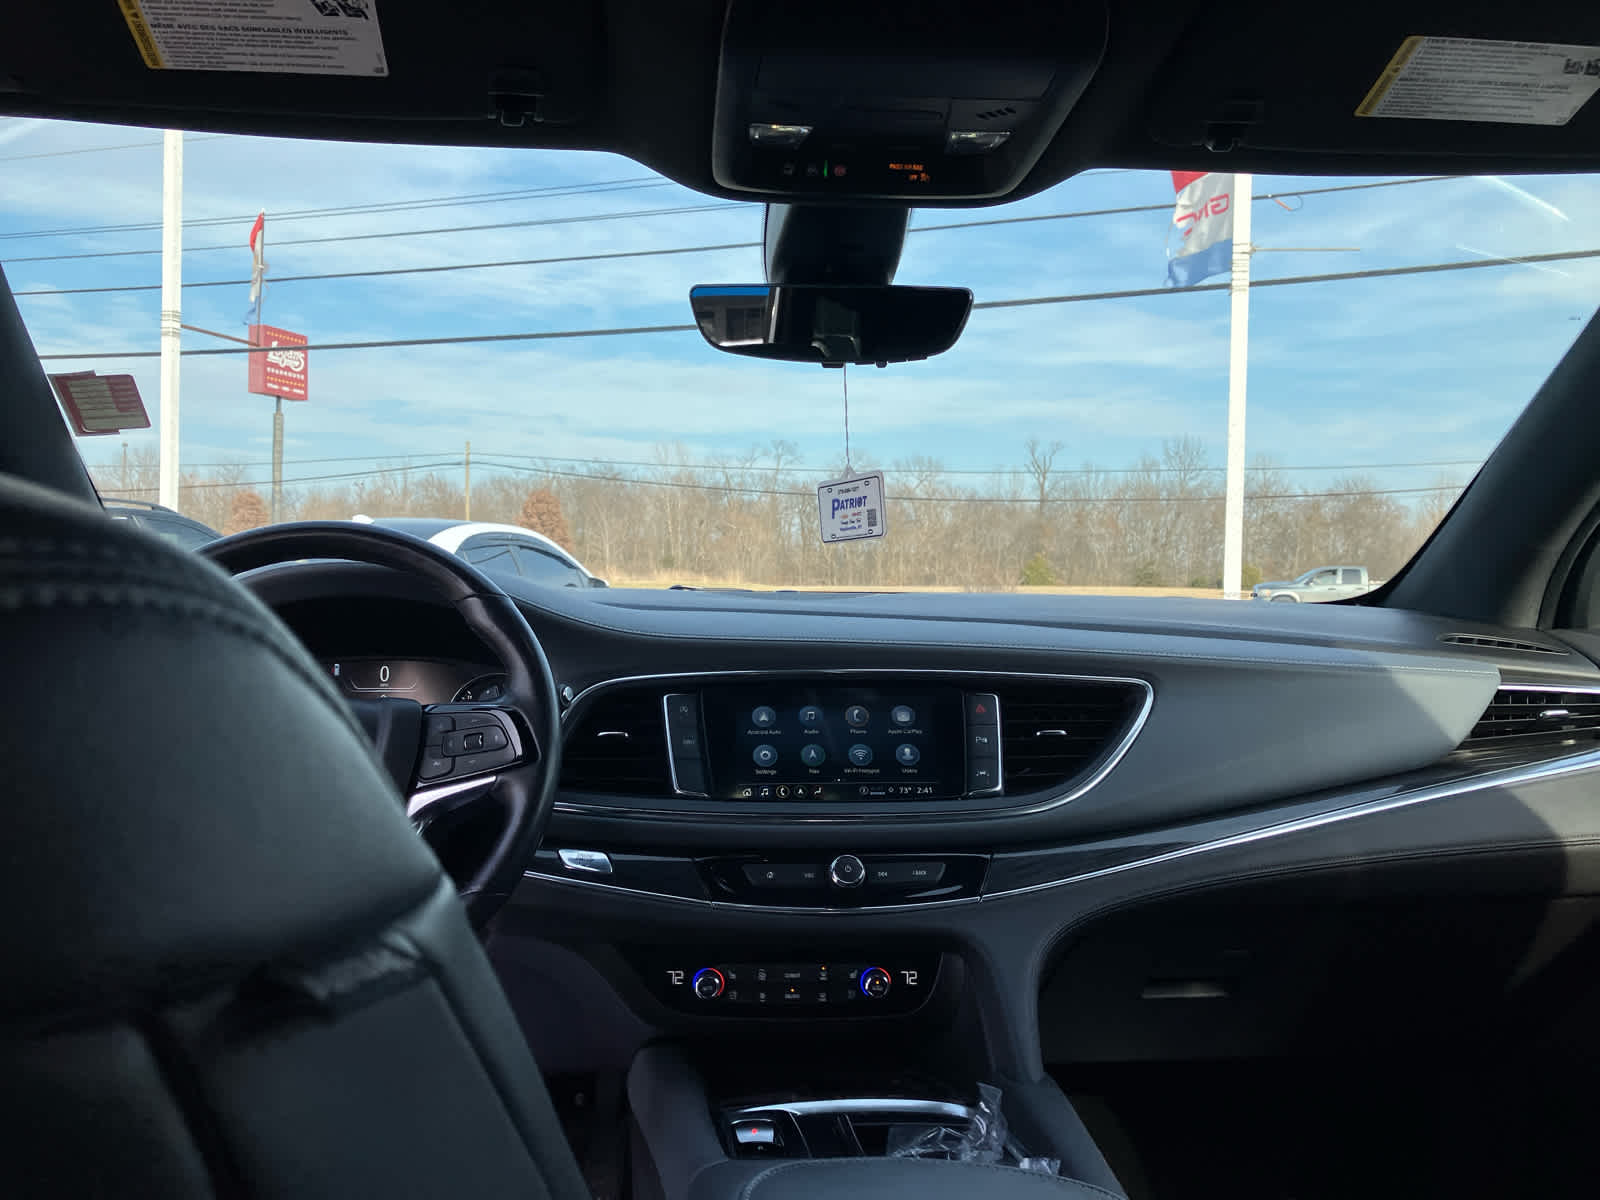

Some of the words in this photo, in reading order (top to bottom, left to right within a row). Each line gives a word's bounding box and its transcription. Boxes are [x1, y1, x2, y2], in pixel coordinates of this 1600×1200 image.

[831, 495, 867, 520] PATRIOT
[379, 665, 390, 682] 0
[916, 786, 933, 794] 2:41
[665, 970, 685, 985] 72
[900, 970, 919, 985] 72
